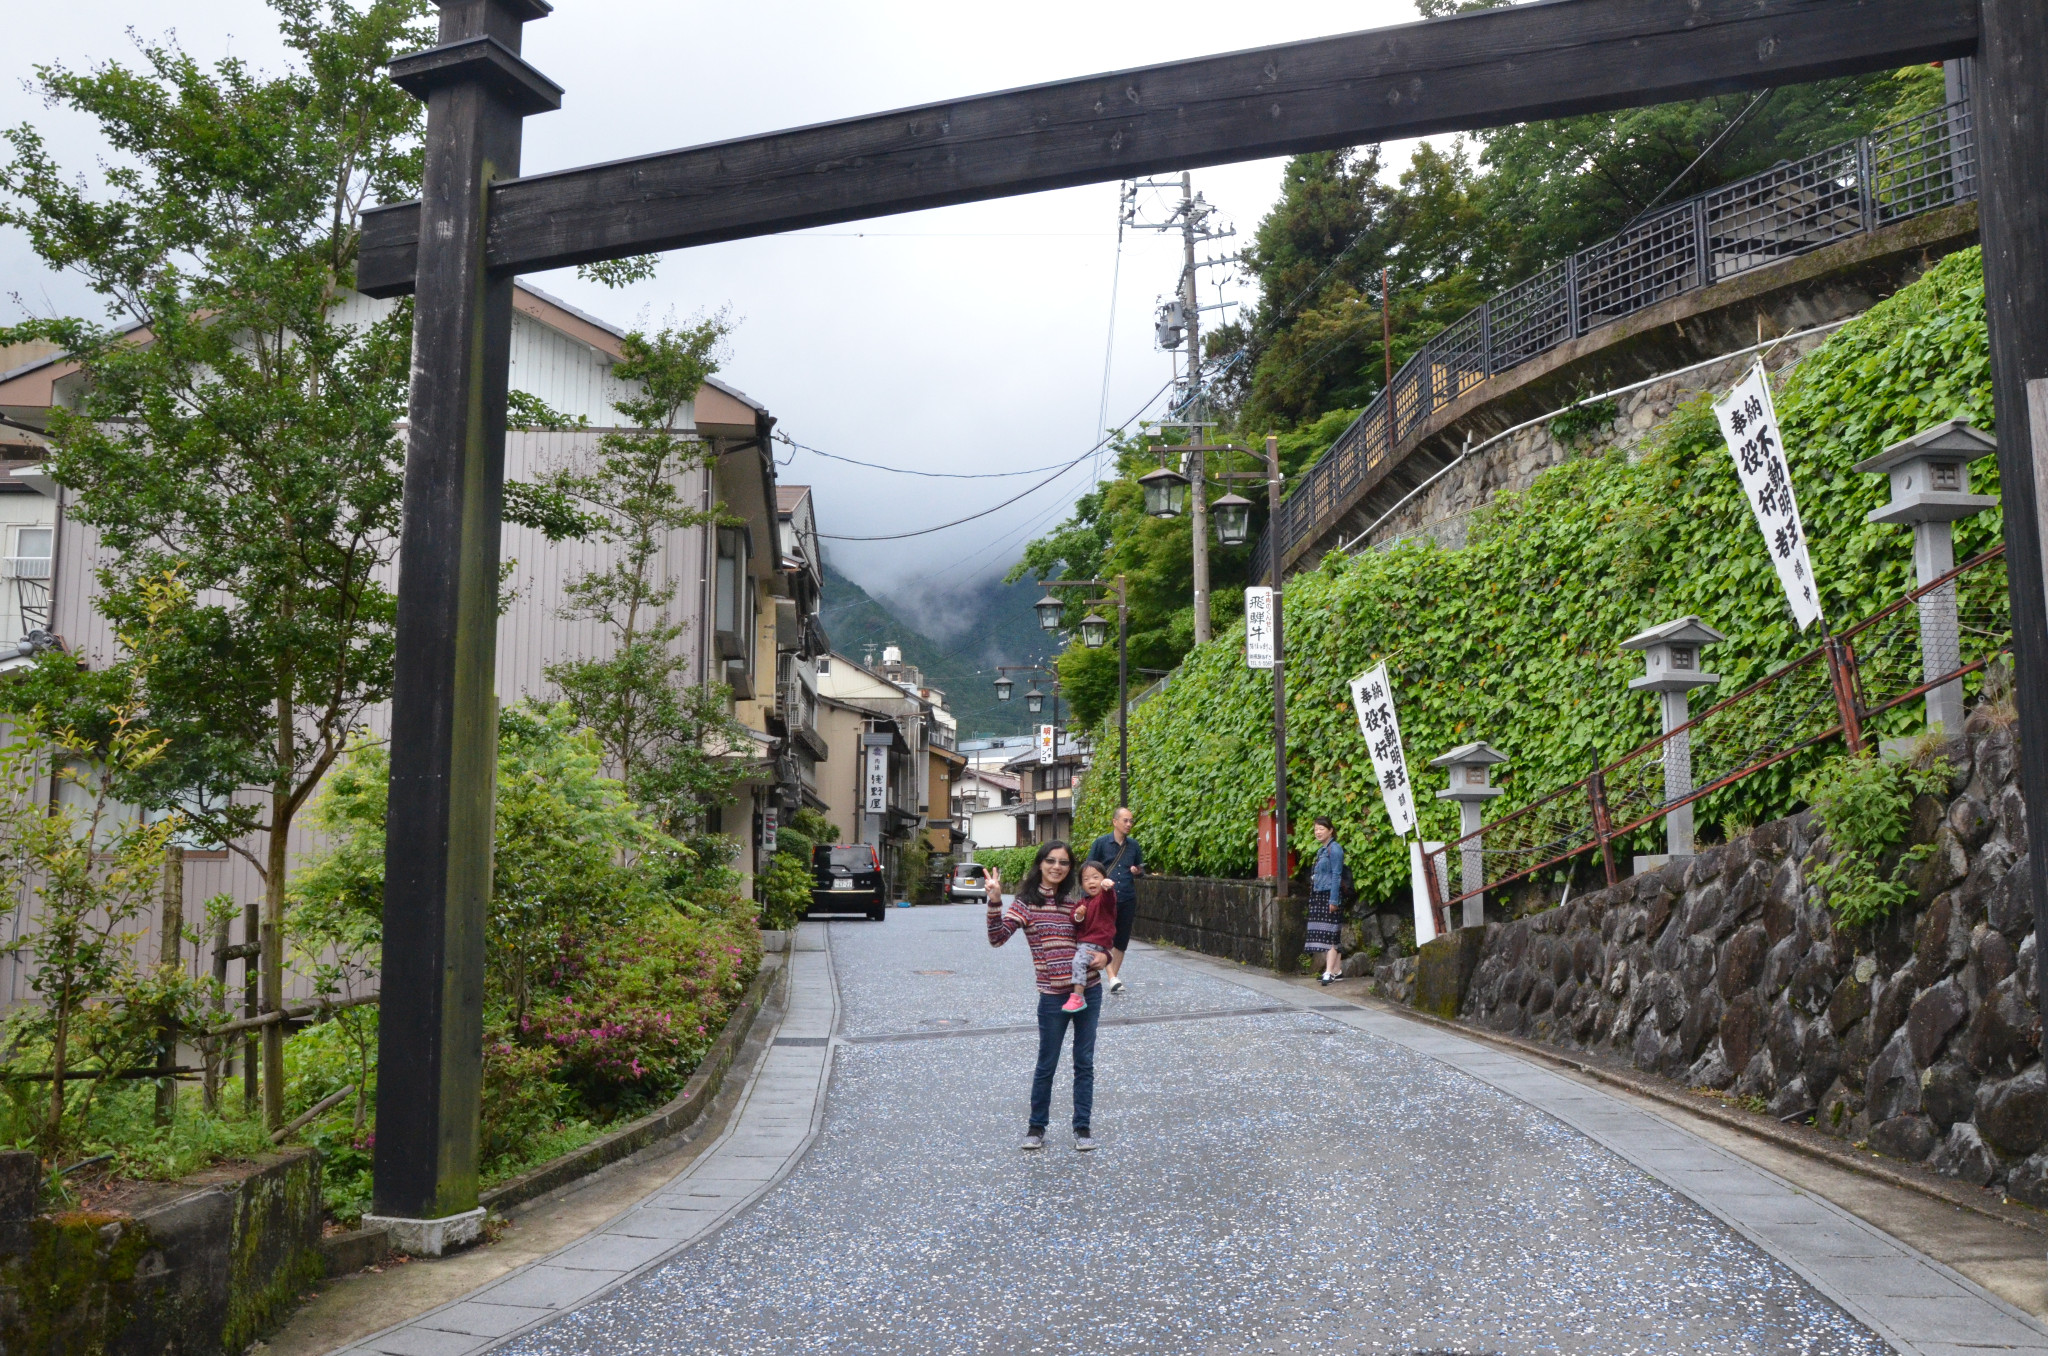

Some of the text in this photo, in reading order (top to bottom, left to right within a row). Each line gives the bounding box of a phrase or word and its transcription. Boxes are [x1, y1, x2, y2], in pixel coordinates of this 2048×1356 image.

[1730, 395, 1763, 436] 奉納
[1740, 439, 1790, 559] 役行者
[1755, 425, 1798, 549] 不動明王
[1249, 595, 1265, 642] 飛騨牛
[1360, 681, 1384, 706] 奉納
[1364, 709, 1397, 791] 役行者
[1377, 702, 1406, 787] 不動明王
